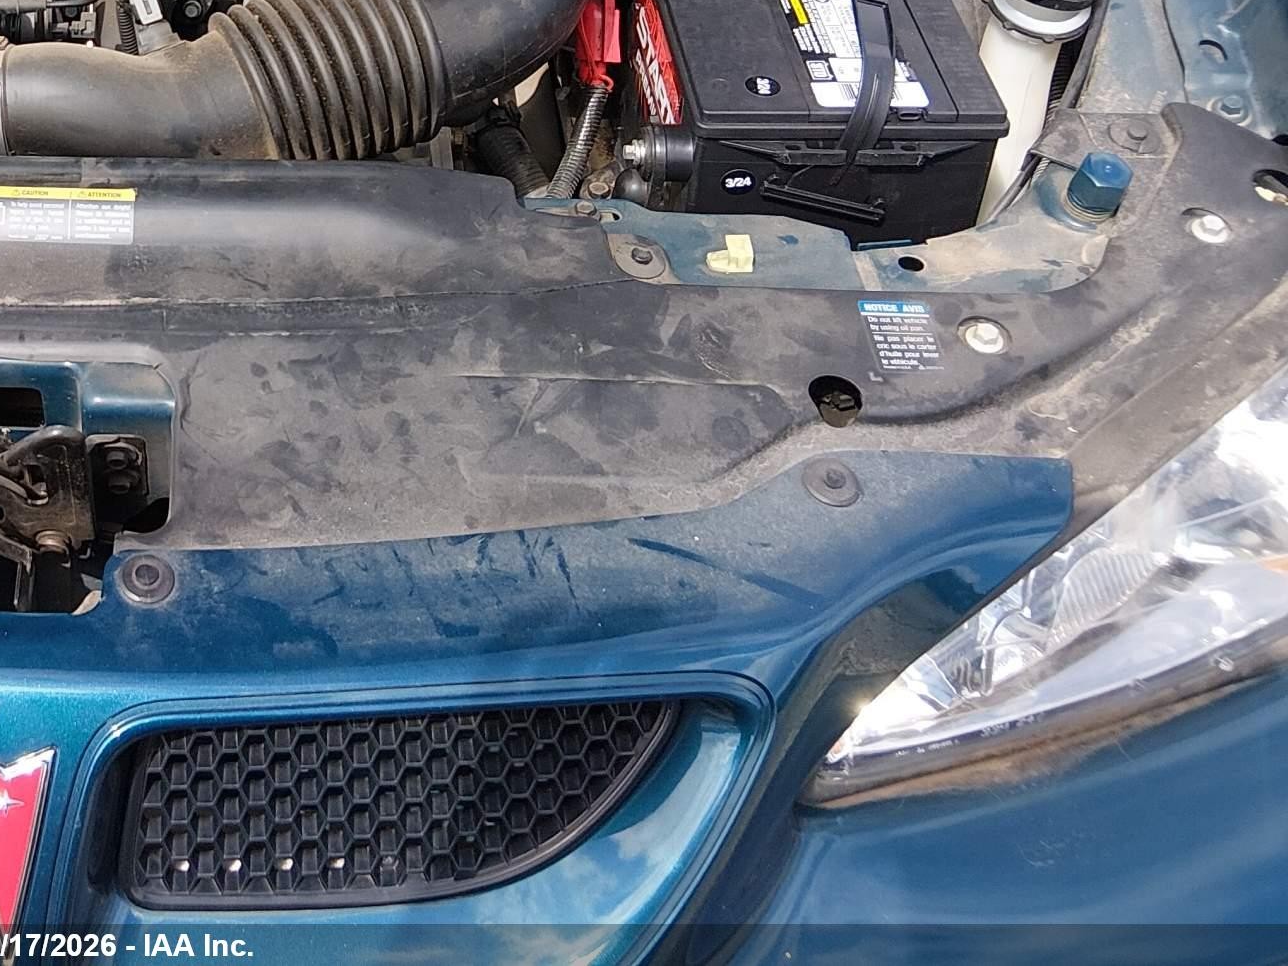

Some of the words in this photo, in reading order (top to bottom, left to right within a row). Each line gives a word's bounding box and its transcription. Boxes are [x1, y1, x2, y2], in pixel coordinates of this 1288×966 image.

[725, 177, 752, 188] 3/24
[864, 303, 898, 313] NOTICE
[902, 305, 925, 314] AVIS
